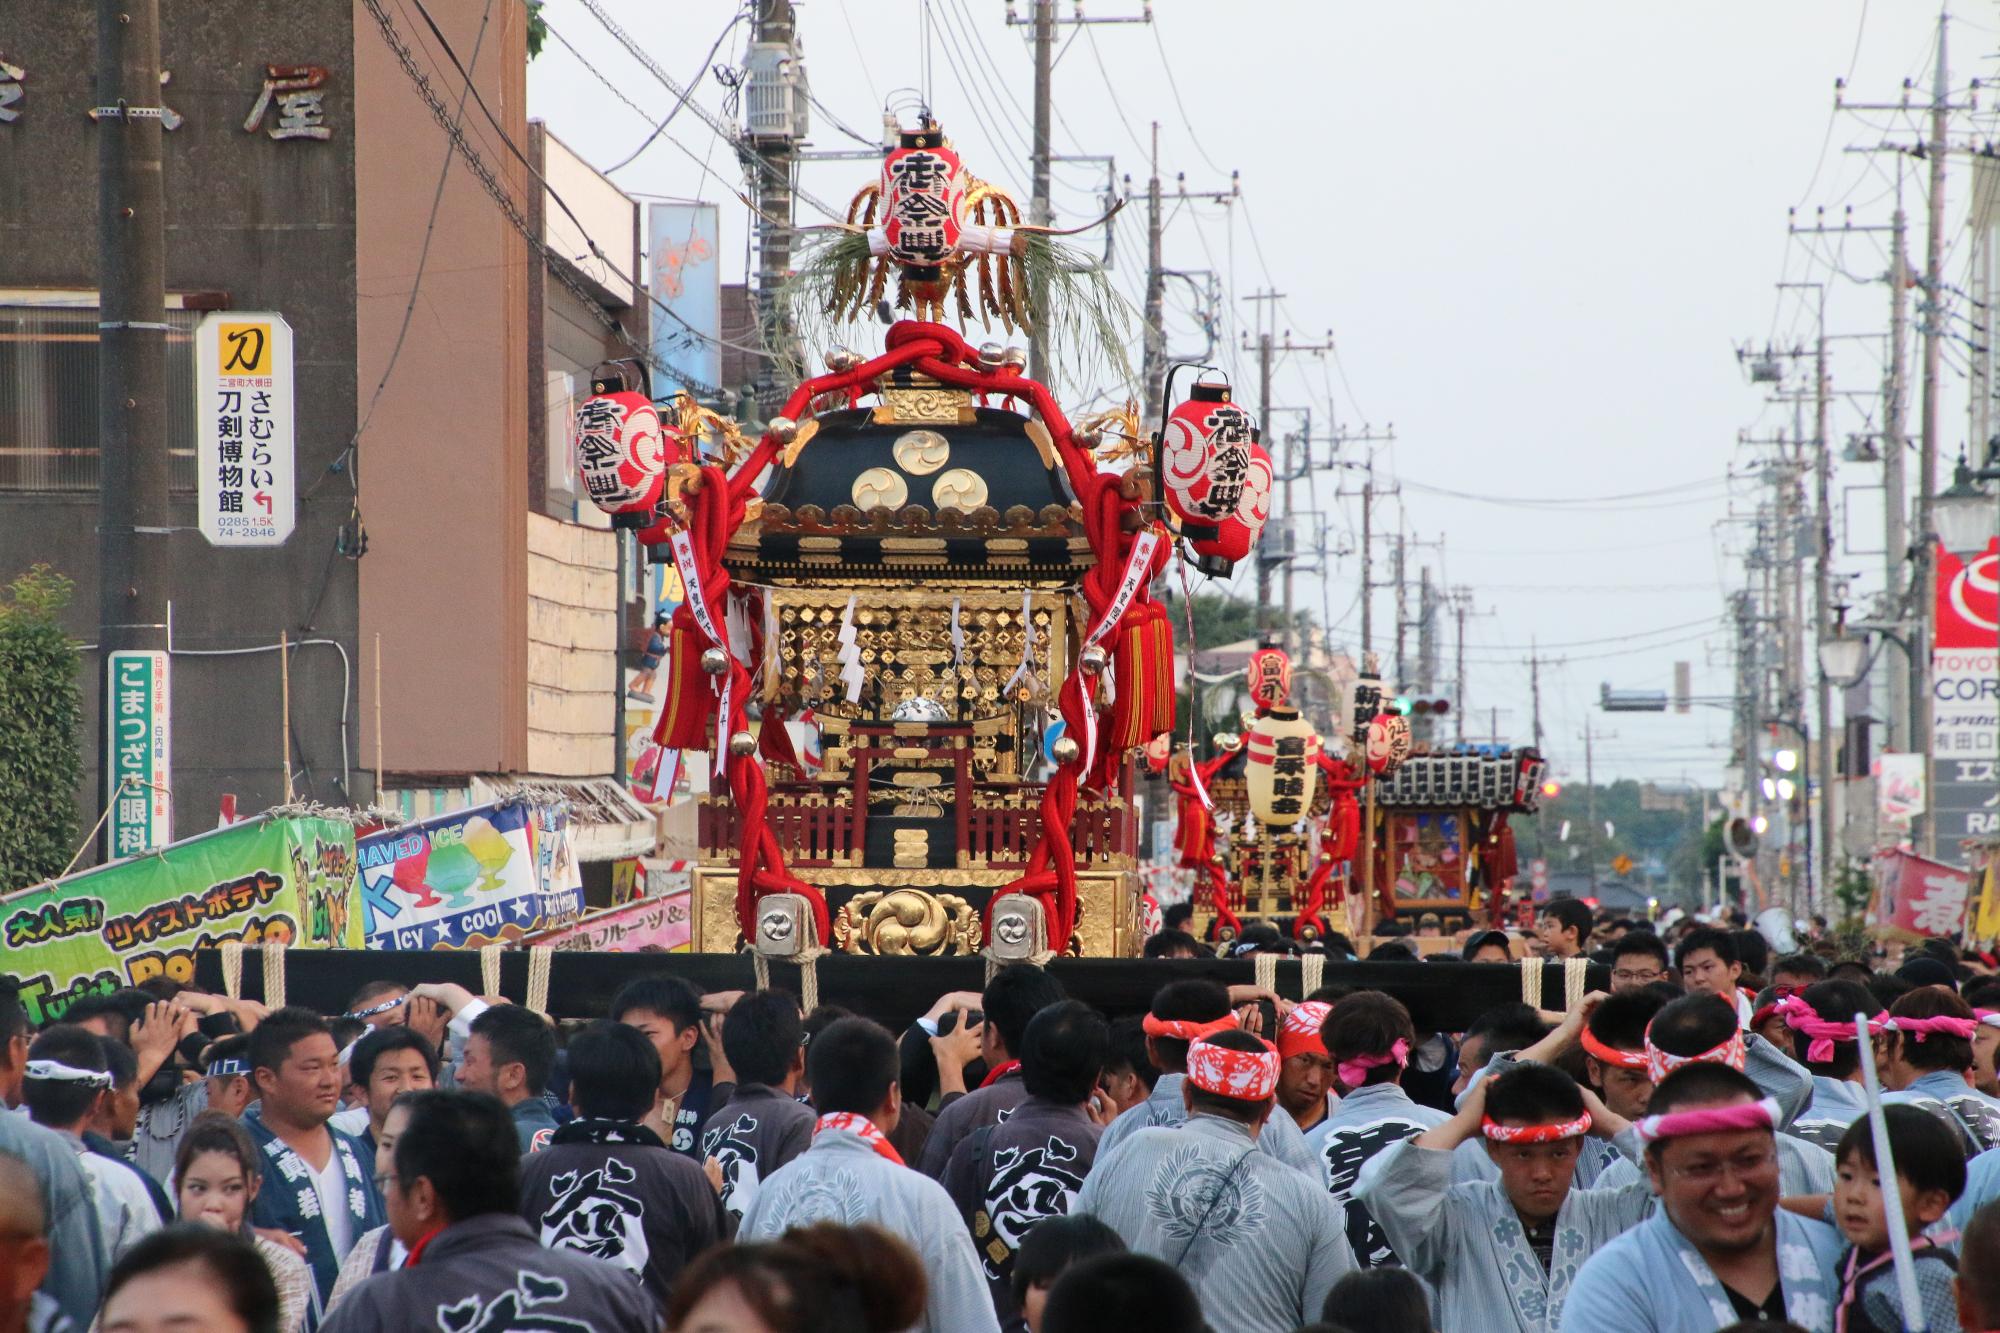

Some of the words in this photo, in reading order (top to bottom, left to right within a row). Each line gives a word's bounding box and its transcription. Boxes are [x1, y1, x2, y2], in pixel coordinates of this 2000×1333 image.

[225, 327, 264, 371] 刀
[218, 391, 243, 513] 刀剣博物館
[249, 391, 274, 489] さむらい
[218, 517, 249, 527] 0285
[219, 527, 276, 537] 74-2846
[118, 662, 147, 854] こまつざき眼科
[1956, 761, 2000, 782] エス
[429, 823, 465, 851] ICE
[107, 876, 279, 948] ツイストポテト
[461, 902, 503, 933] cool
